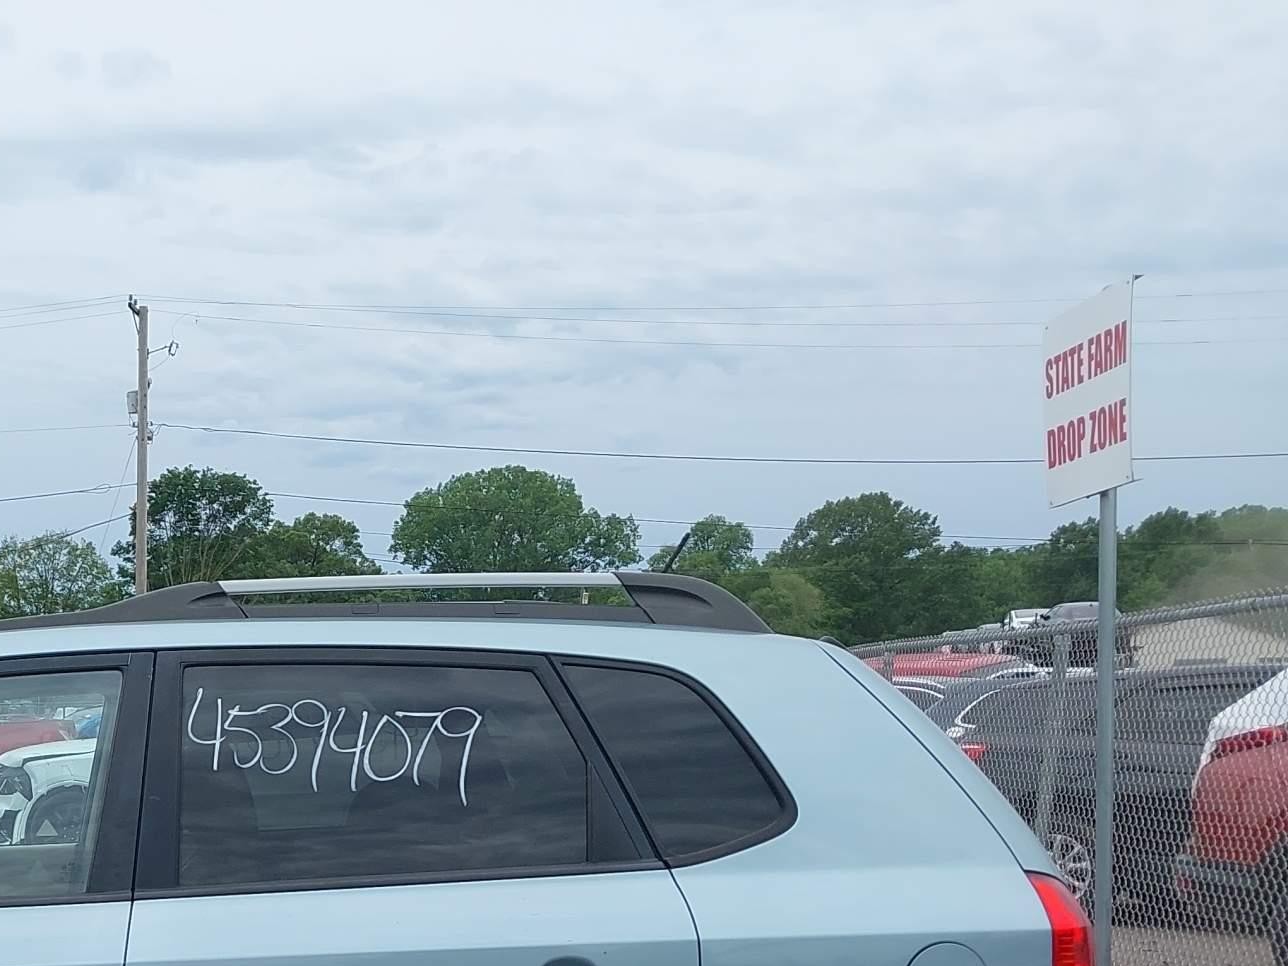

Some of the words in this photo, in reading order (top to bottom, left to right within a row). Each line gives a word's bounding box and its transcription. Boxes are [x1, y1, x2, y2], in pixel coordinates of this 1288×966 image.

[1045, 342, 1084, 400] STATE
[1087, 320, 1128, 381] FARM
[1047, 416, 1086, 470] DROP
[1089, 398, 1128, 455] ZONE
[187, 688, 483, 807] 45394079
